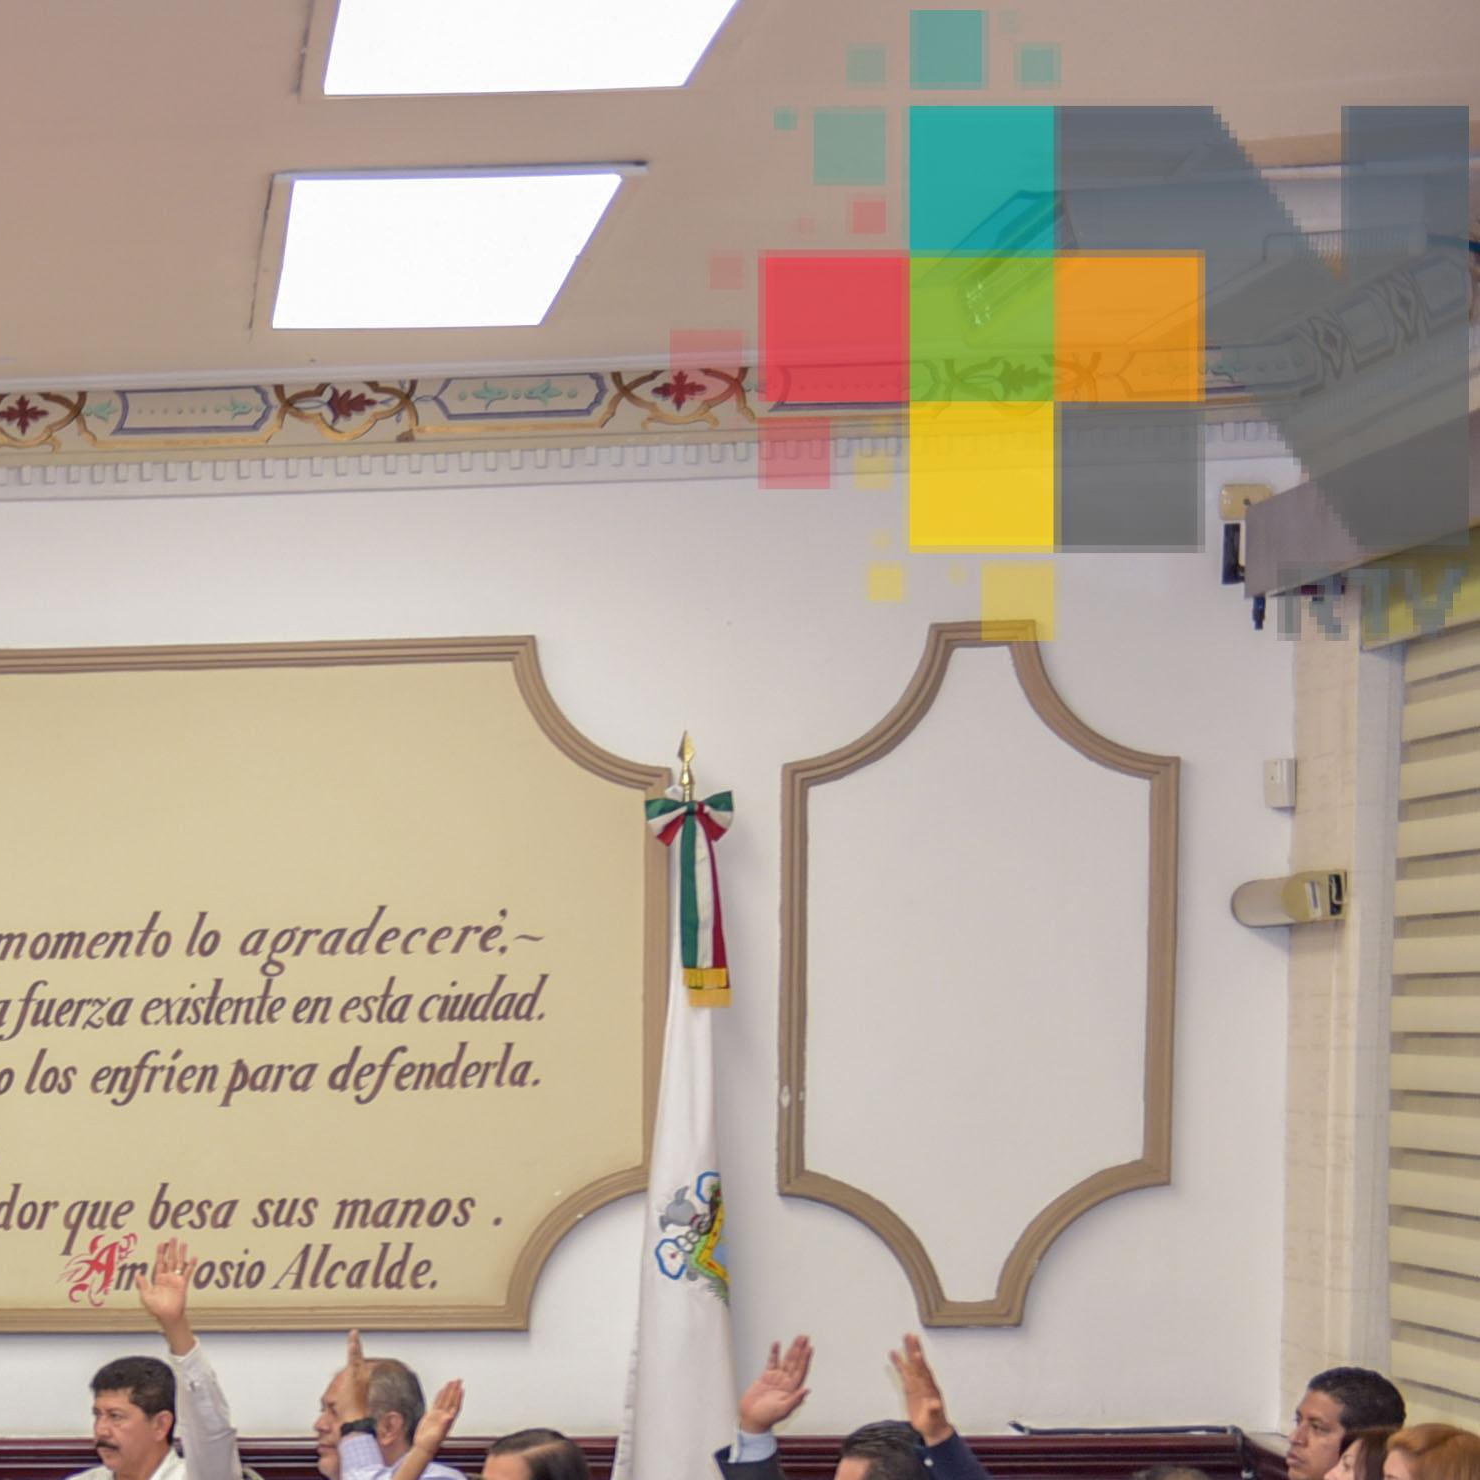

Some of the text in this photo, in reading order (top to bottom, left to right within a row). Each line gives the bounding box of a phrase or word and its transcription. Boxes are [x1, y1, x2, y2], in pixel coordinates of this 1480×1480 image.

[185, 911, 221, 957] lo
[140, 977, 286, 1027] existente
[292, 996, 333, 1024] en
[339, 976, 413, 1024] esta
[418, 974, 549, 1023] ciudad.
[24, 1048, 77, 1094] los
[90, 1048, 219, 1106] enfríen
[219, 1059, 319, 1107] para
[328, 1041, 540, 1105] defenderla.
[61, 1200, 135, 1256] que
[148, 1182, 239, 1230] besa
[252, 1197, 319, 1228] sus
[59, 1233, 437, 1306] Amosio Alcalde.
